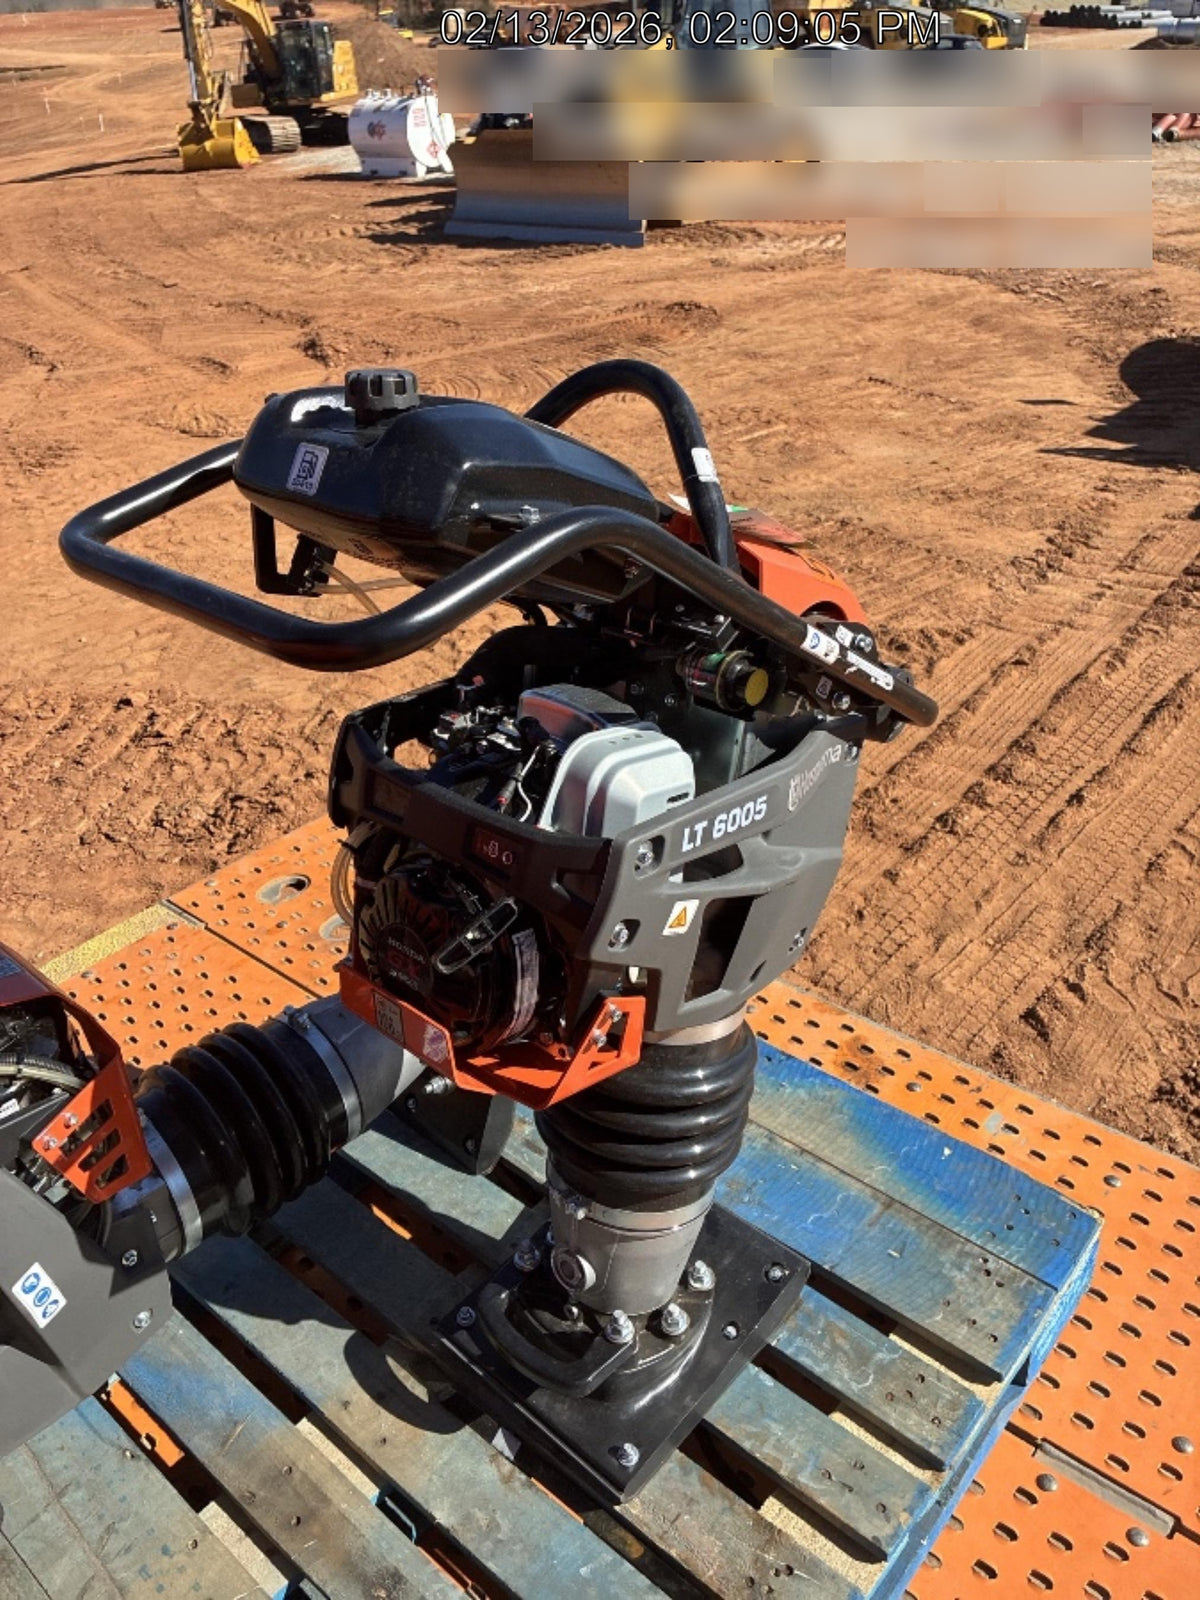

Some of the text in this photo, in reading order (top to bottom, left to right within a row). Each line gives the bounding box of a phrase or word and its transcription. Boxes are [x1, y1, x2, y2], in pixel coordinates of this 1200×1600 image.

[682, 795, 768, 852] LT 6005
[387, 936, 426, 964] HONDA
